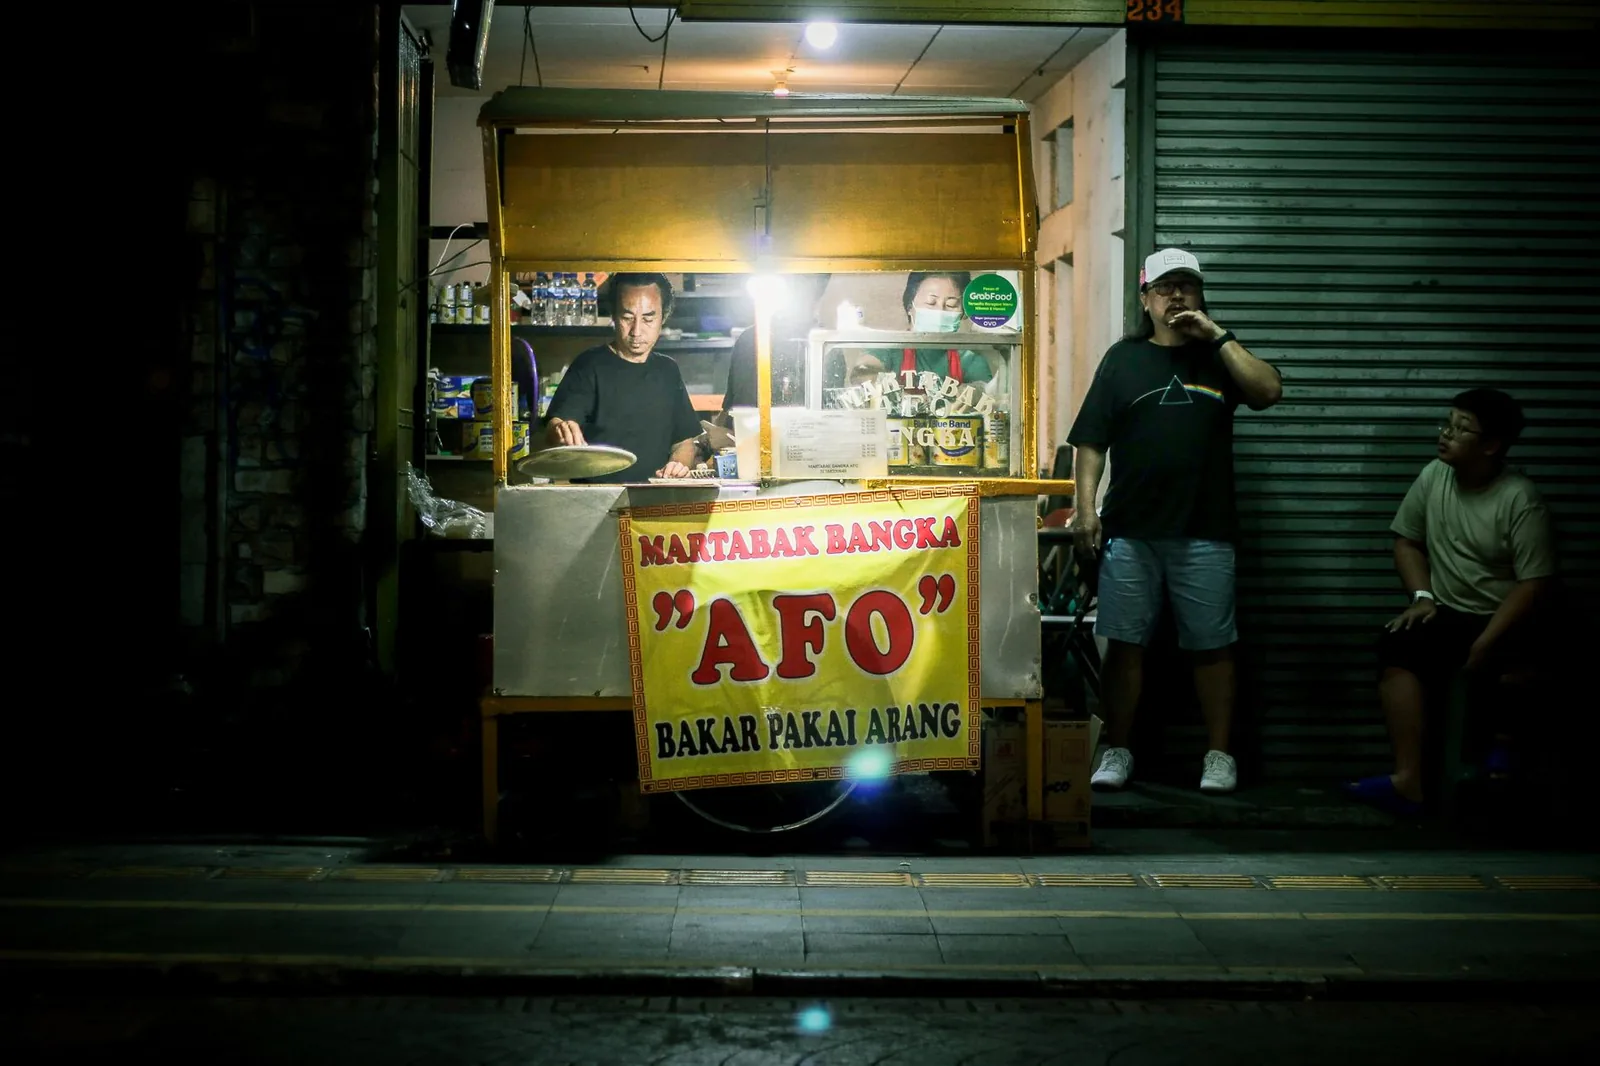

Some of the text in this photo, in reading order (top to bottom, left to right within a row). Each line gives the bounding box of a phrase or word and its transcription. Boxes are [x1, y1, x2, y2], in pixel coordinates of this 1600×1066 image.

[1128, 0, 1181, 21] 234
[969, 292, 1013, 301] GrabFood
[932, 420, 971, 428] Blue Band
[638, 516, 961, 567] MARTABAK BANGKA
[655, 702, 961, 759] BAKAR PAKAI ARANG
